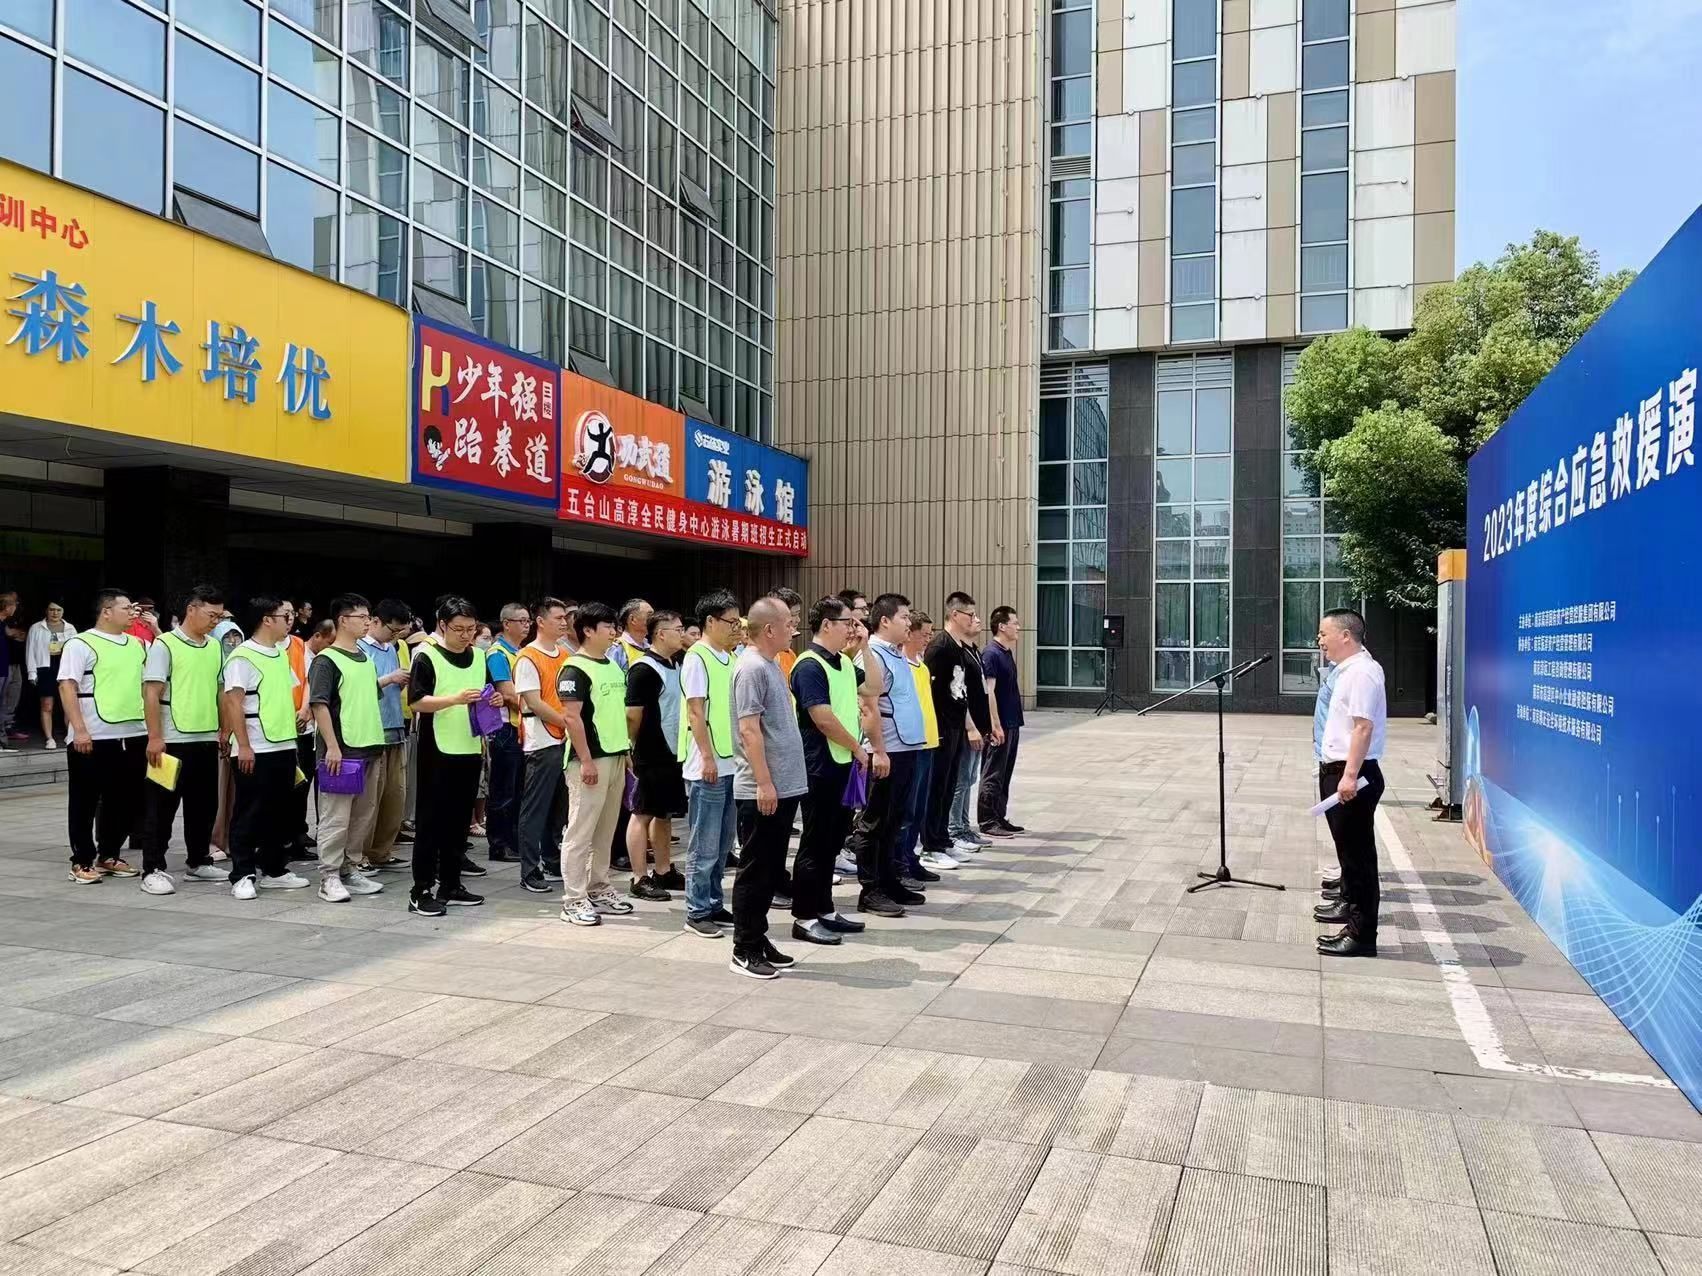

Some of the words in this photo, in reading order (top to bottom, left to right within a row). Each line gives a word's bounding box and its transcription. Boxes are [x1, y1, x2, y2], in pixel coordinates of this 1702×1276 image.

[0, 193, 88, 249] 训中心
[6, 269, 333, 420] 森木培优
[452, 354, 538, 424] 少年强
[454, 417, 553, 484] 跆拳道
[623, 474, 664, 490] GONGWUDAO
[1483, 368, 1698, 562] 2023年度综合应急救援演
[566, 487, 807, 551] 五台山高淳全民健身中心游泳暑期班招生正式启动
[706, 458, 795, 525] 游泳馆
